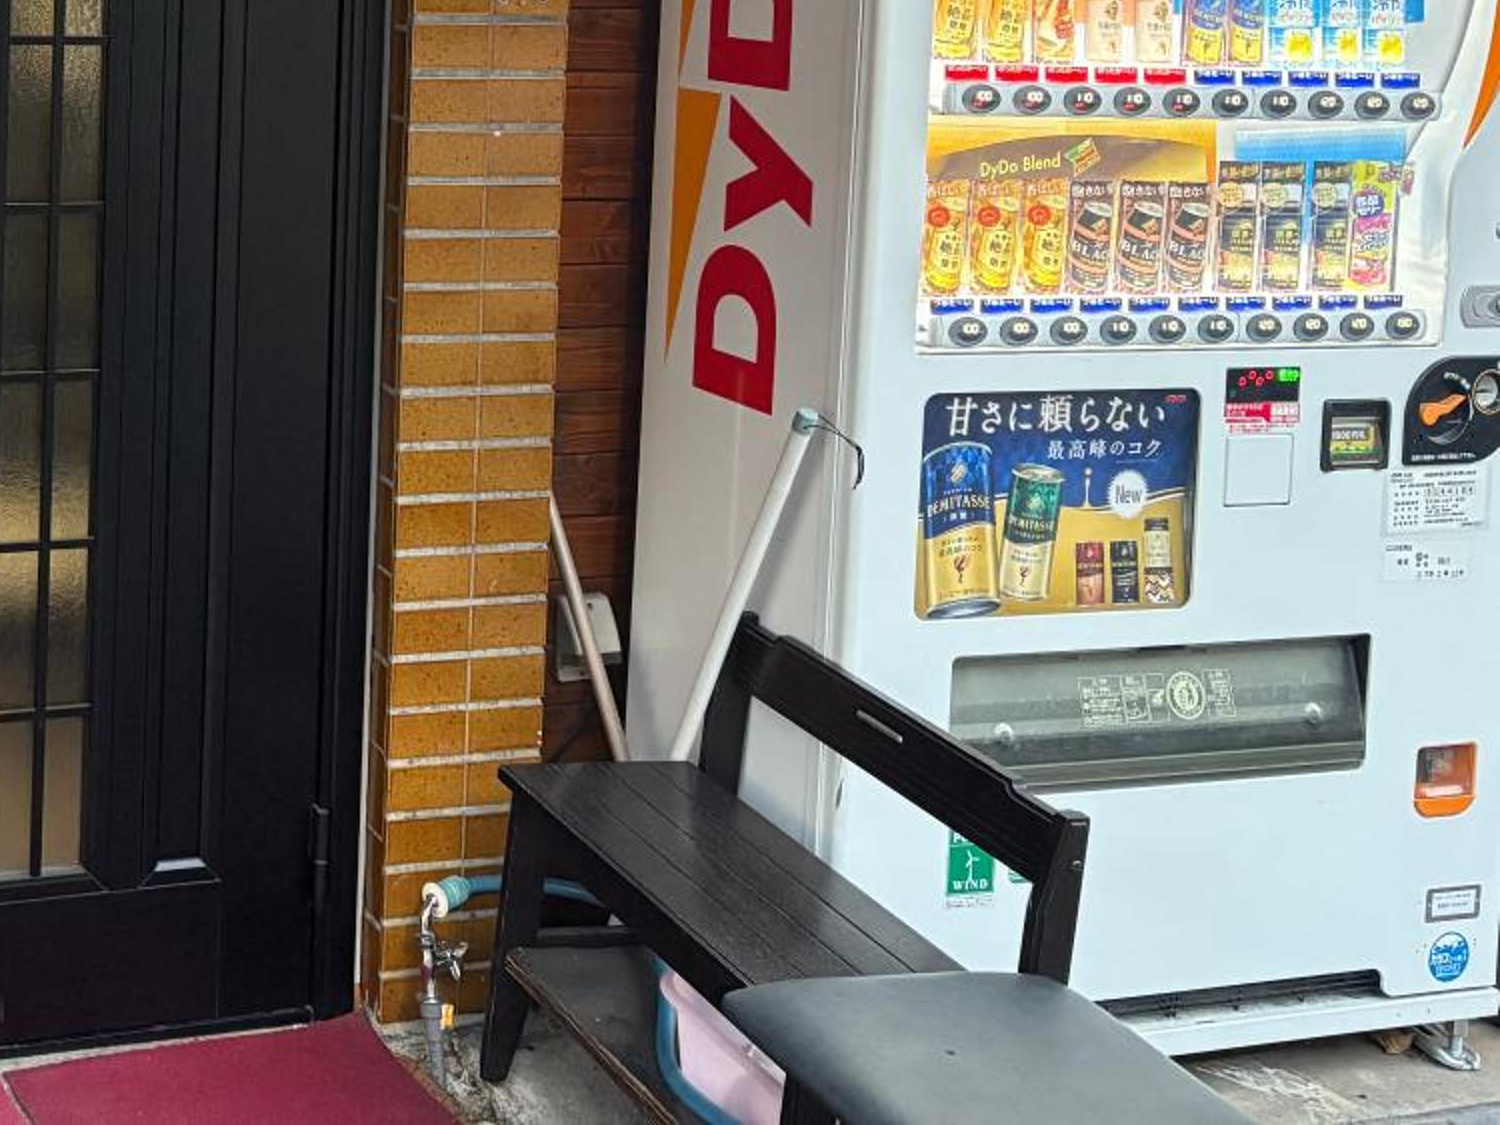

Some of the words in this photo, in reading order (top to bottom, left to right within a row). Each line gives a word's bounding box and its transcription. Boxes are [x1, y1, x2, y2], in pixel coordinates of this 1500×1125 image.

[980, 160, 1018, 179] DyDo
[1023, 152, 1061, 170] Blend
[946, 394, 1165, 437] 甘さに頼らない
[1047, 439, 1162, 460] 最高峰のコク
[927, 494, 991, 517] DEMITASSE
[1115, 484, 1143, 506] New
[952, 878, 988, 890] WIND
